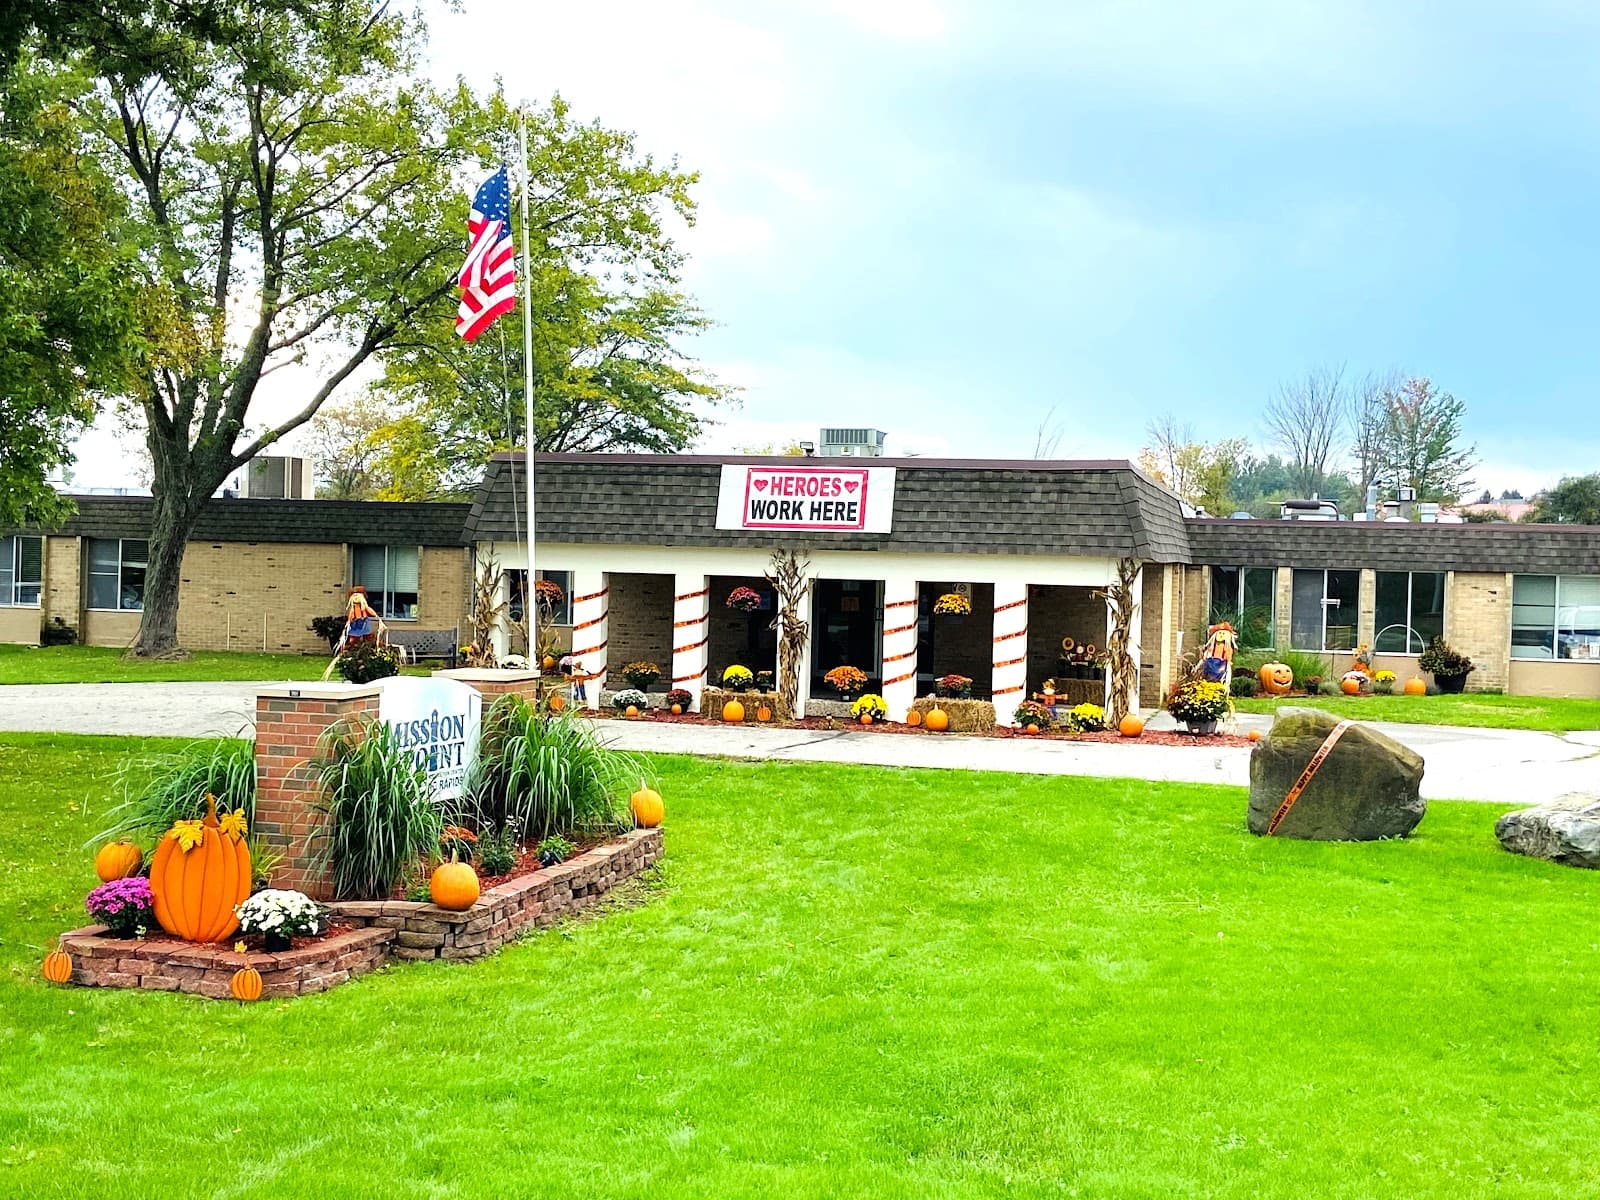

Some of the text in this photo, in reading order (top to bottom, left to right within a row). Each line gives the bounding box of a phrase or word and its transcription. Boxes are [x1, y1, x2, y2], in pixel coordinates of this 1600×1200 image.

[770, 476, 841, 497] HEROES
[751, 500, 857, 521] WORK HERE
[411, 741, 465, 771] OINT
